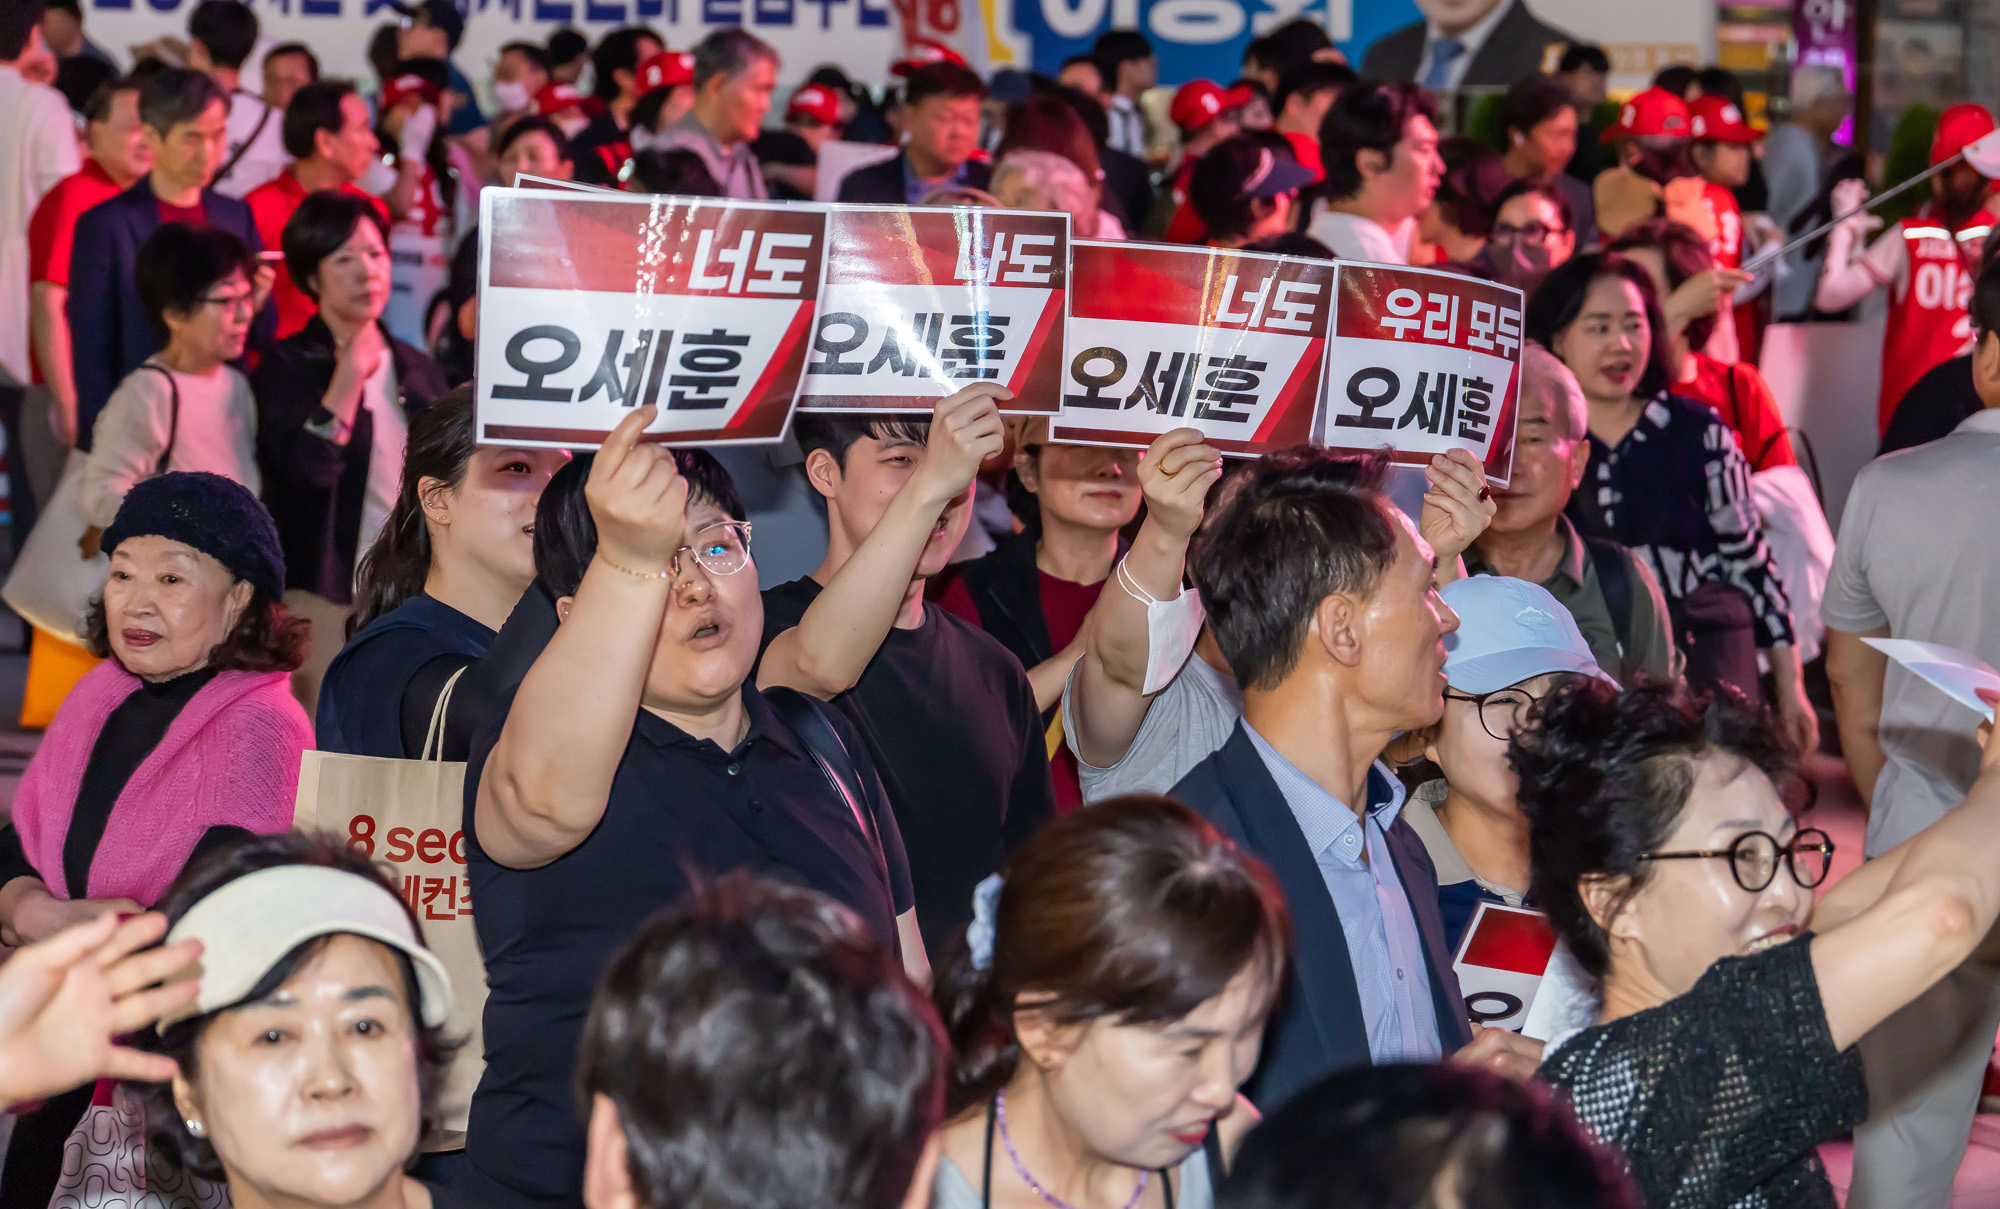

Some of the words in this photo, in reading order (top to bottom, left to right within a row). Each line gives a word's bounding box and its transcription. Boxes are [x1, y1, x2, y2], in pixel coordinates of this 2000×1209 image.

[687, 228, 813, 294] 너도
[953, 231, 1056, 284] 나도
[1214, 274, 1322, 332] 너도
[1380, 288, 1460, 344] 우리
[1467, 299, 1521, 358] 모두
[490, 324, 751, 411] 오세훈
[807, 311, 1011, 379] 오세훈
[1063, 346, 1268, 424] 오세훈
[1334, 366, 1494, 444] 오세훈
[346, 814, 377, 858] 8
